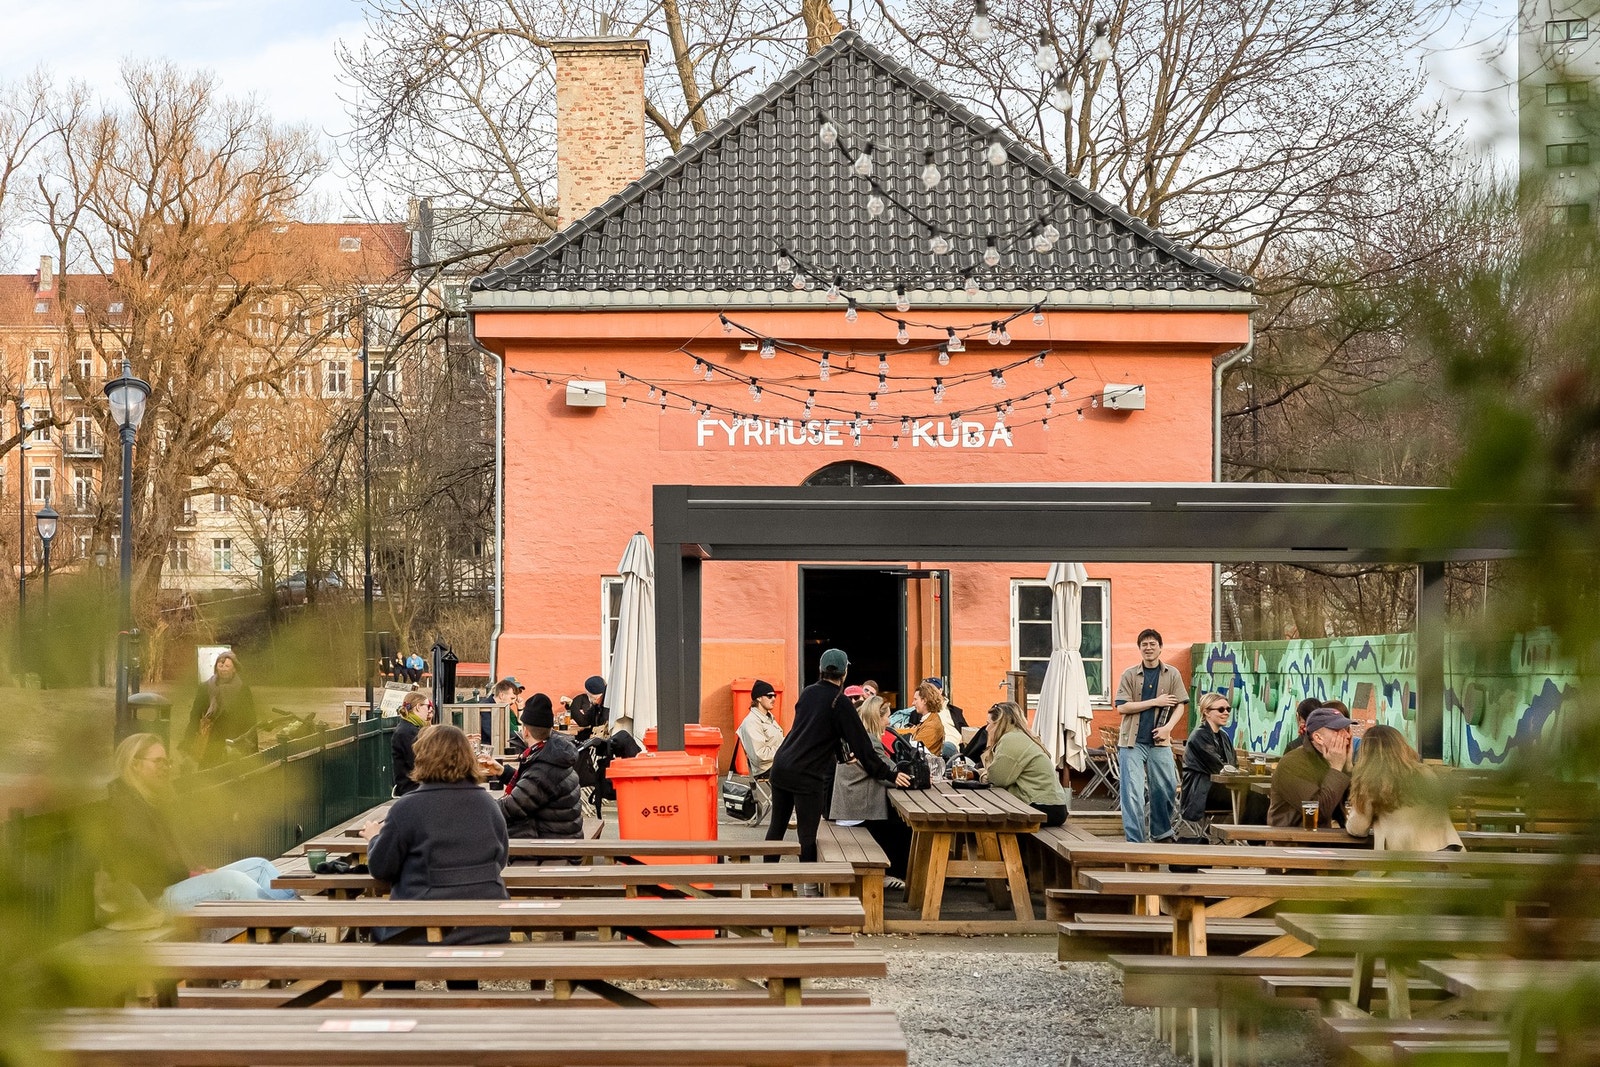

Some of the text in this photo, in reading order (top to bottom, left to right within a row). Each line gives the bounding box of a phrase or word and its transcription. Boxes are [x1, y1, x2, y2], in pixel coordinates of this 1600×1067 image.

[697, 419, 1013, 448] FYRHUSET KUBA
[652, 805, 679, 814] SOCS
